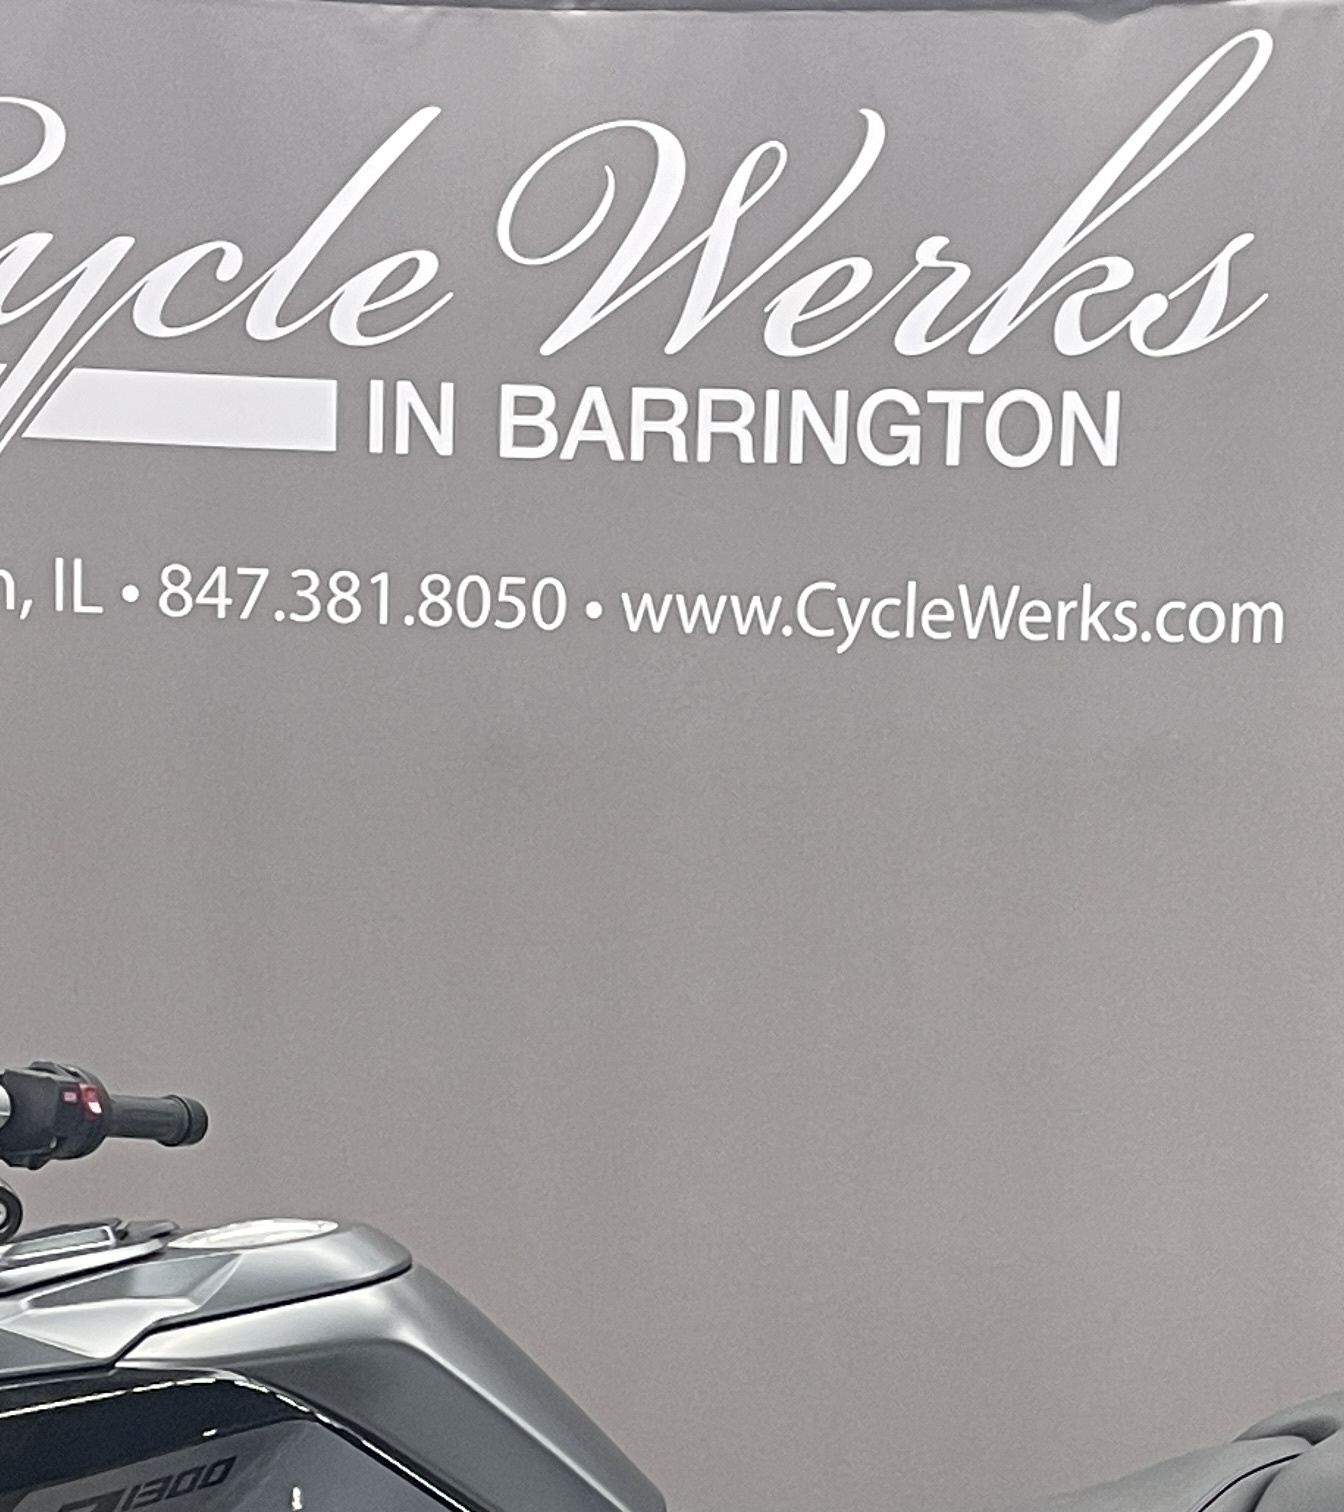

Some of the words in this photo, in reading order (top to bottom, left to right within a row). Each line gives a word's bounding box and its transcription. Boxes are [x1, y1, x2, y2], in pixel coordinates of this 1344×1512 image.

[497, 28, 1274, 357] Werks
[369, 379, 455, 457] IN
[498, 382, 1121, 468] BARRINGTON
[54, 557, 104, 614] IL
[157, 563, 567, 631] 847.381.8050
[620, 579, 1285, 655] www.CycleWerks.com
